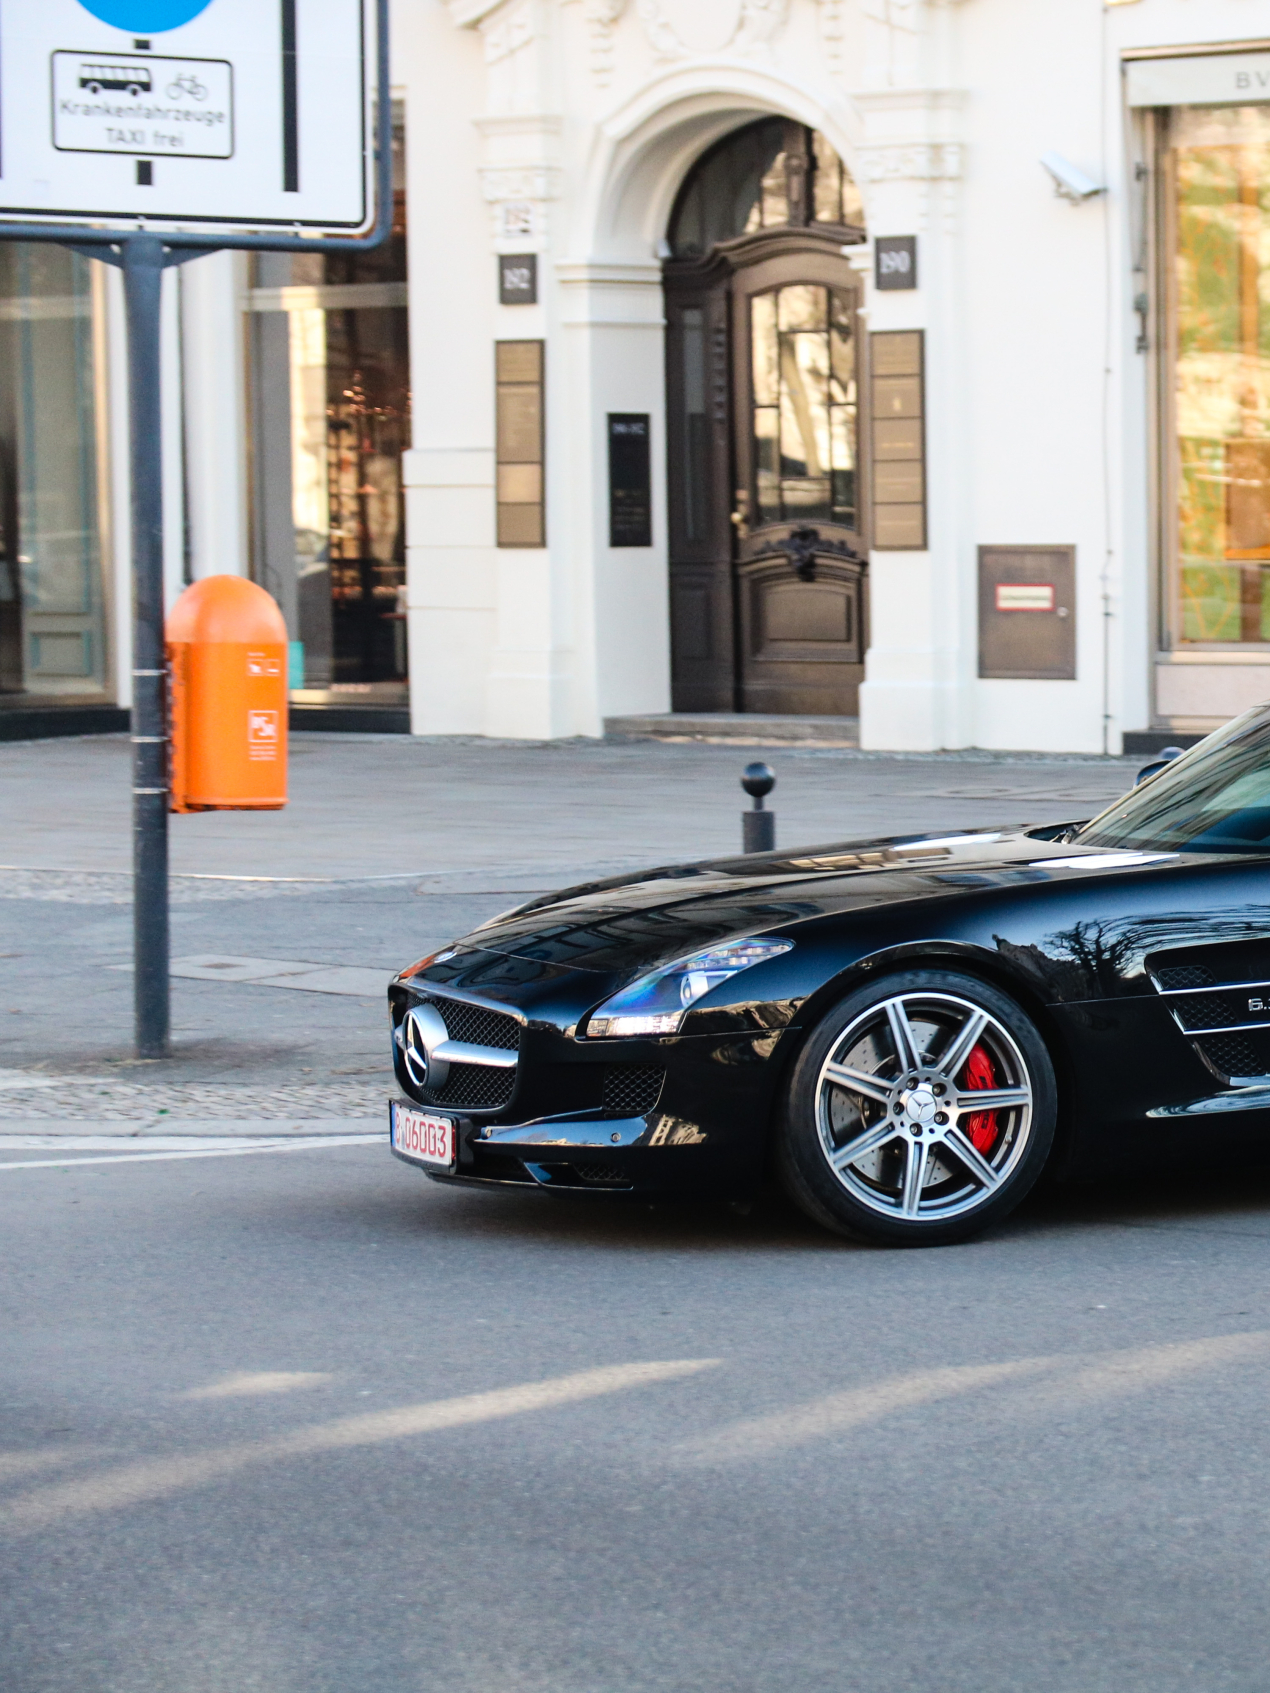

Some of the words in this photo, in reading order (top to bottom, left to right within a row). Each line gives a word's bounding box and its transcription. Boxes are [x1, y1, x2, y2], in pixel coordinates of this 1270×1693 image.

[59, 100, 226, 126] Krankenfahrzeuge
[105, 127, 146, 145] TAXI
[152, 131, 184, 147] frei
[405, 1116, 447, 1158] 06003
